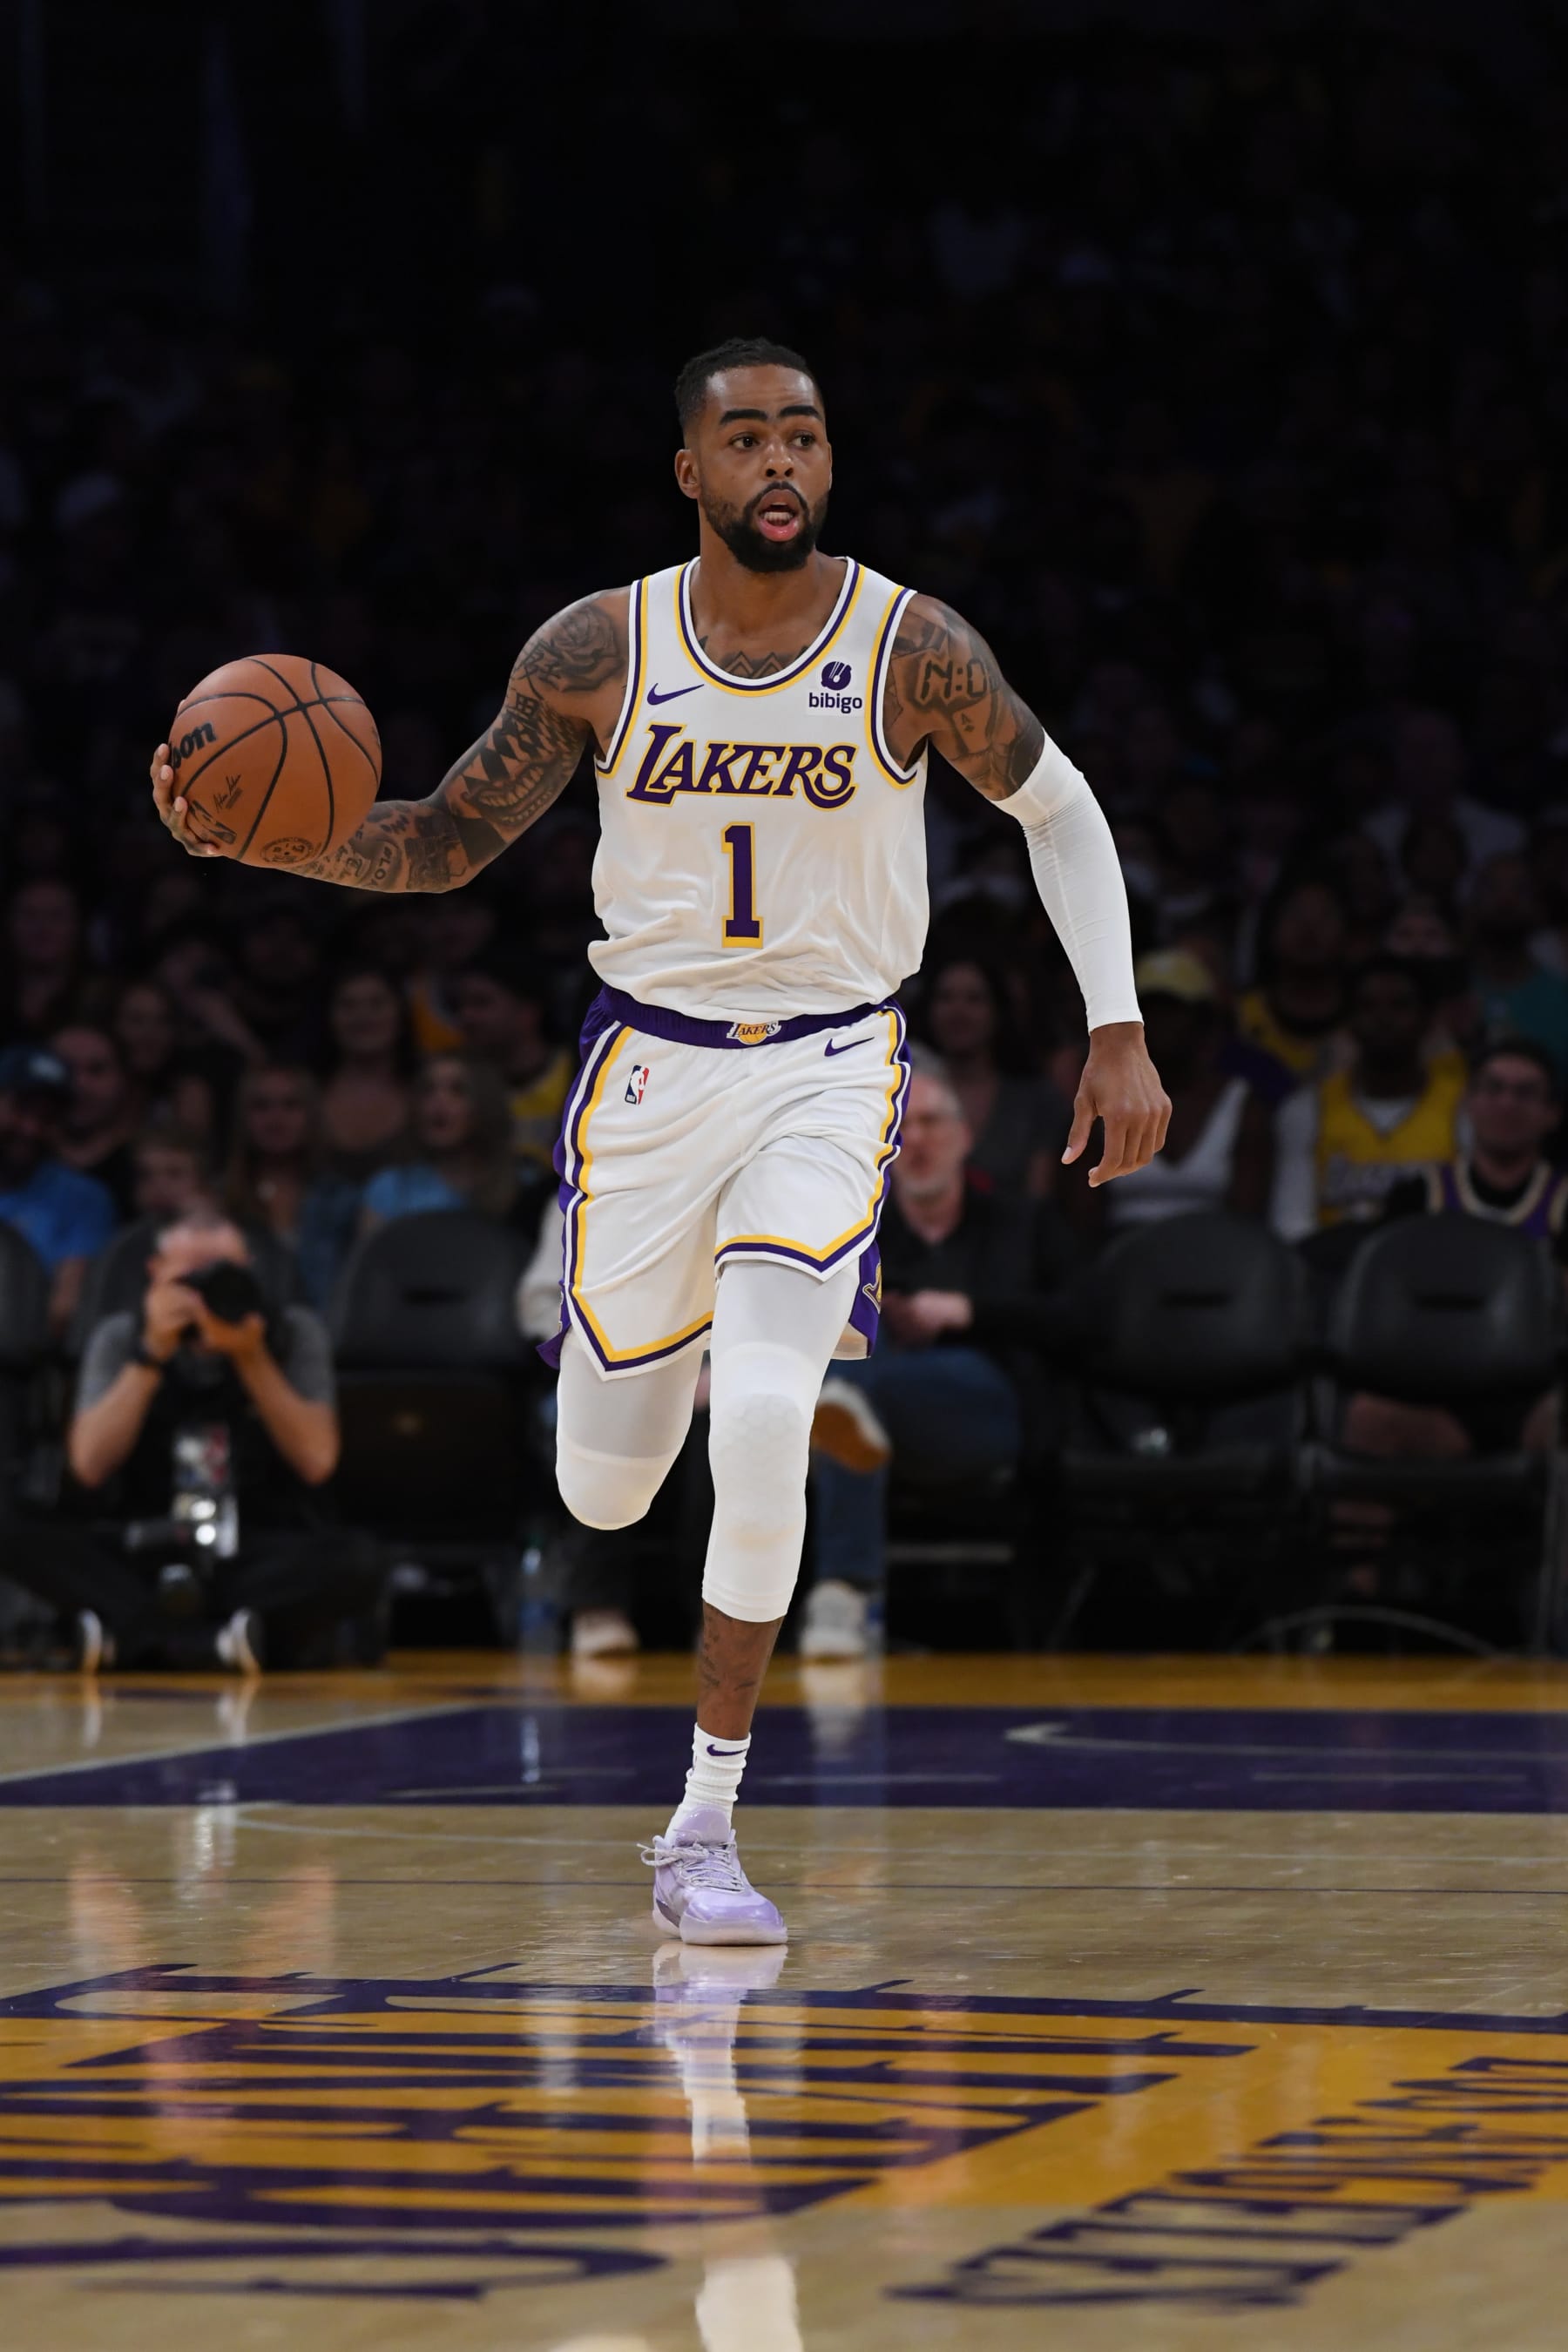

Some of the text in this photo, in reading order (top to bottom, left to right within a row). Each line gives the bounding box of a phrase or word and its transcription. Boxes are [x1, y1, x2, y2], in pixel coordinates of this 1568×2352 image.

[808, 692, 863, 714] bibigo
[625, 722, 859, 811] LAKERS
[721, 821, 764, 948] 1
[727, 1023, 780, 1038] LAKERS
[880, 2114, 1568, 2310] ANGELES
